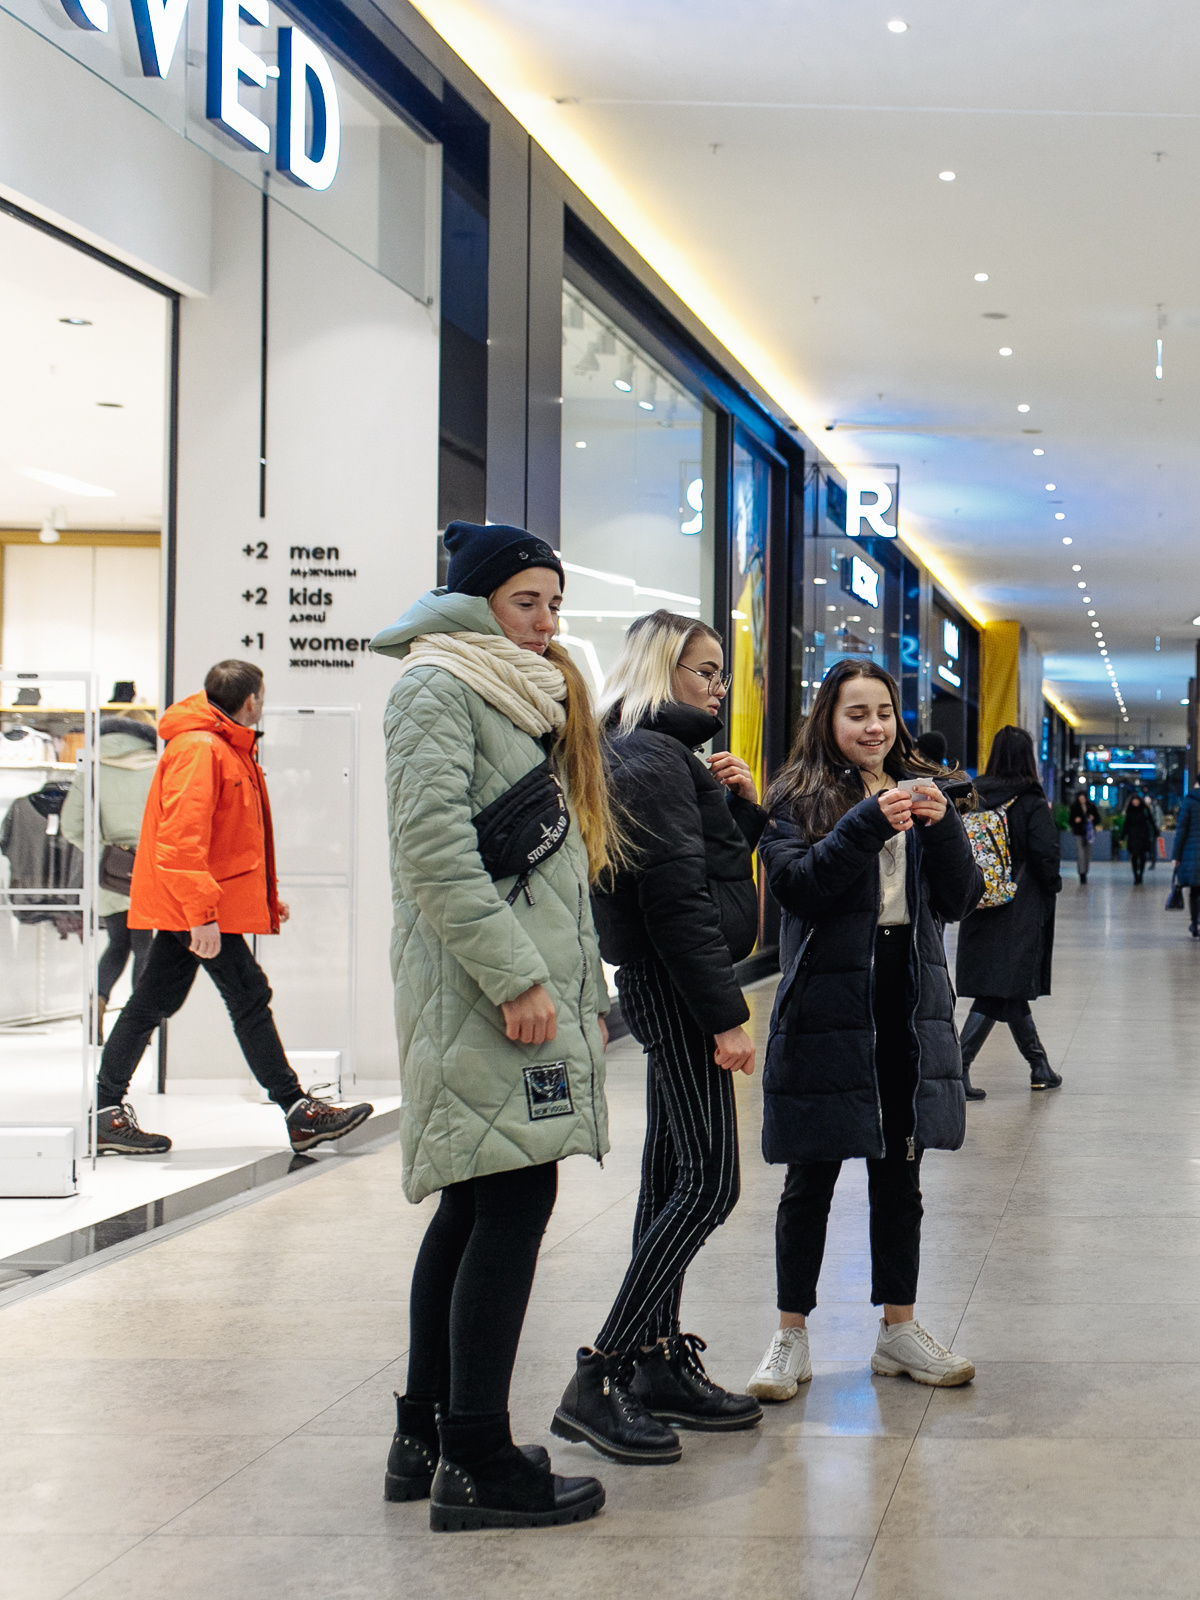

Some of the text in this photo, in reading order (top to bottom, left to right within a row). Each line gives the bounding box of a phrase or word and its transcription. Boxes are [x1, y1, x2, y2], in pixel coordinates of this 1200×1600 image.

[60, 0, 341, 191] VED
[846, 480, 897, 538] R
[243, 541, 339, 560] +2 men
[242, 587, 333, 606] +2 kids
[241, 632, 373, 652] +1 women
[527, 838, 553, 864] STONE
